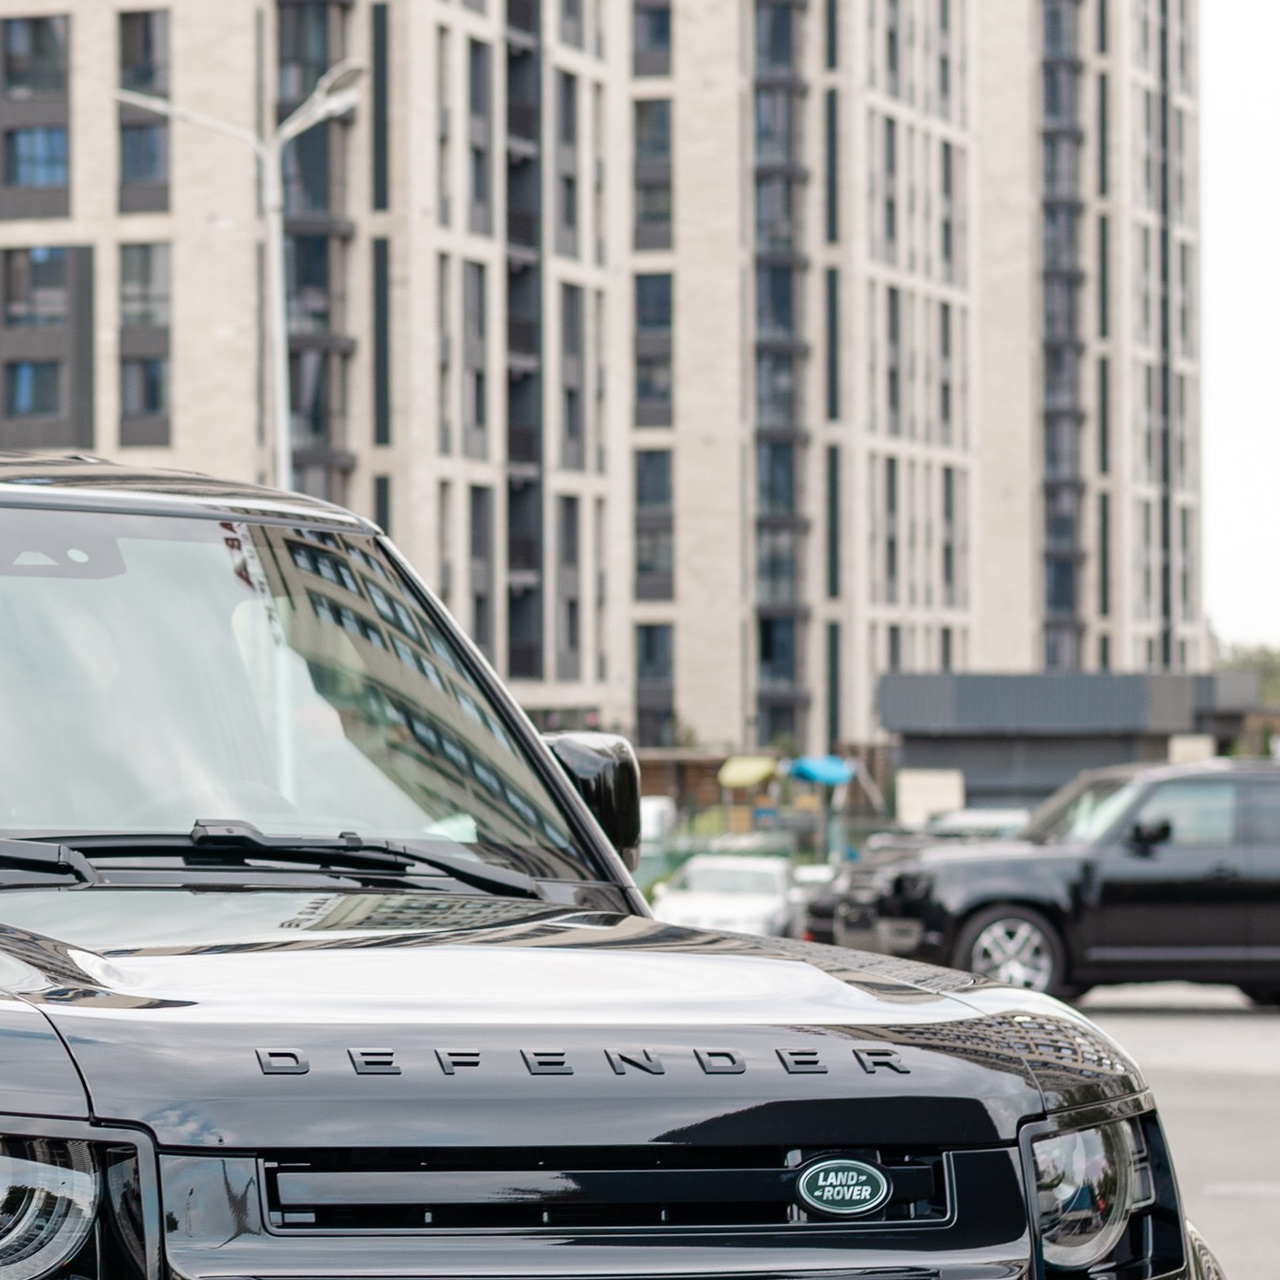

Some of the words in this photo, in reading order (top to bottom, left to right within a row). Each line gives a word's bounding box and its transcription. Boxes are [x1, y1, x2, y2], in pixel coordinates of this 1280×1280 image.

[255, 1047, 911, 1075] DEFENDER
[817, 1171, 858, 1186] LAND
[822, 1186, 872, 1200] ROVER
